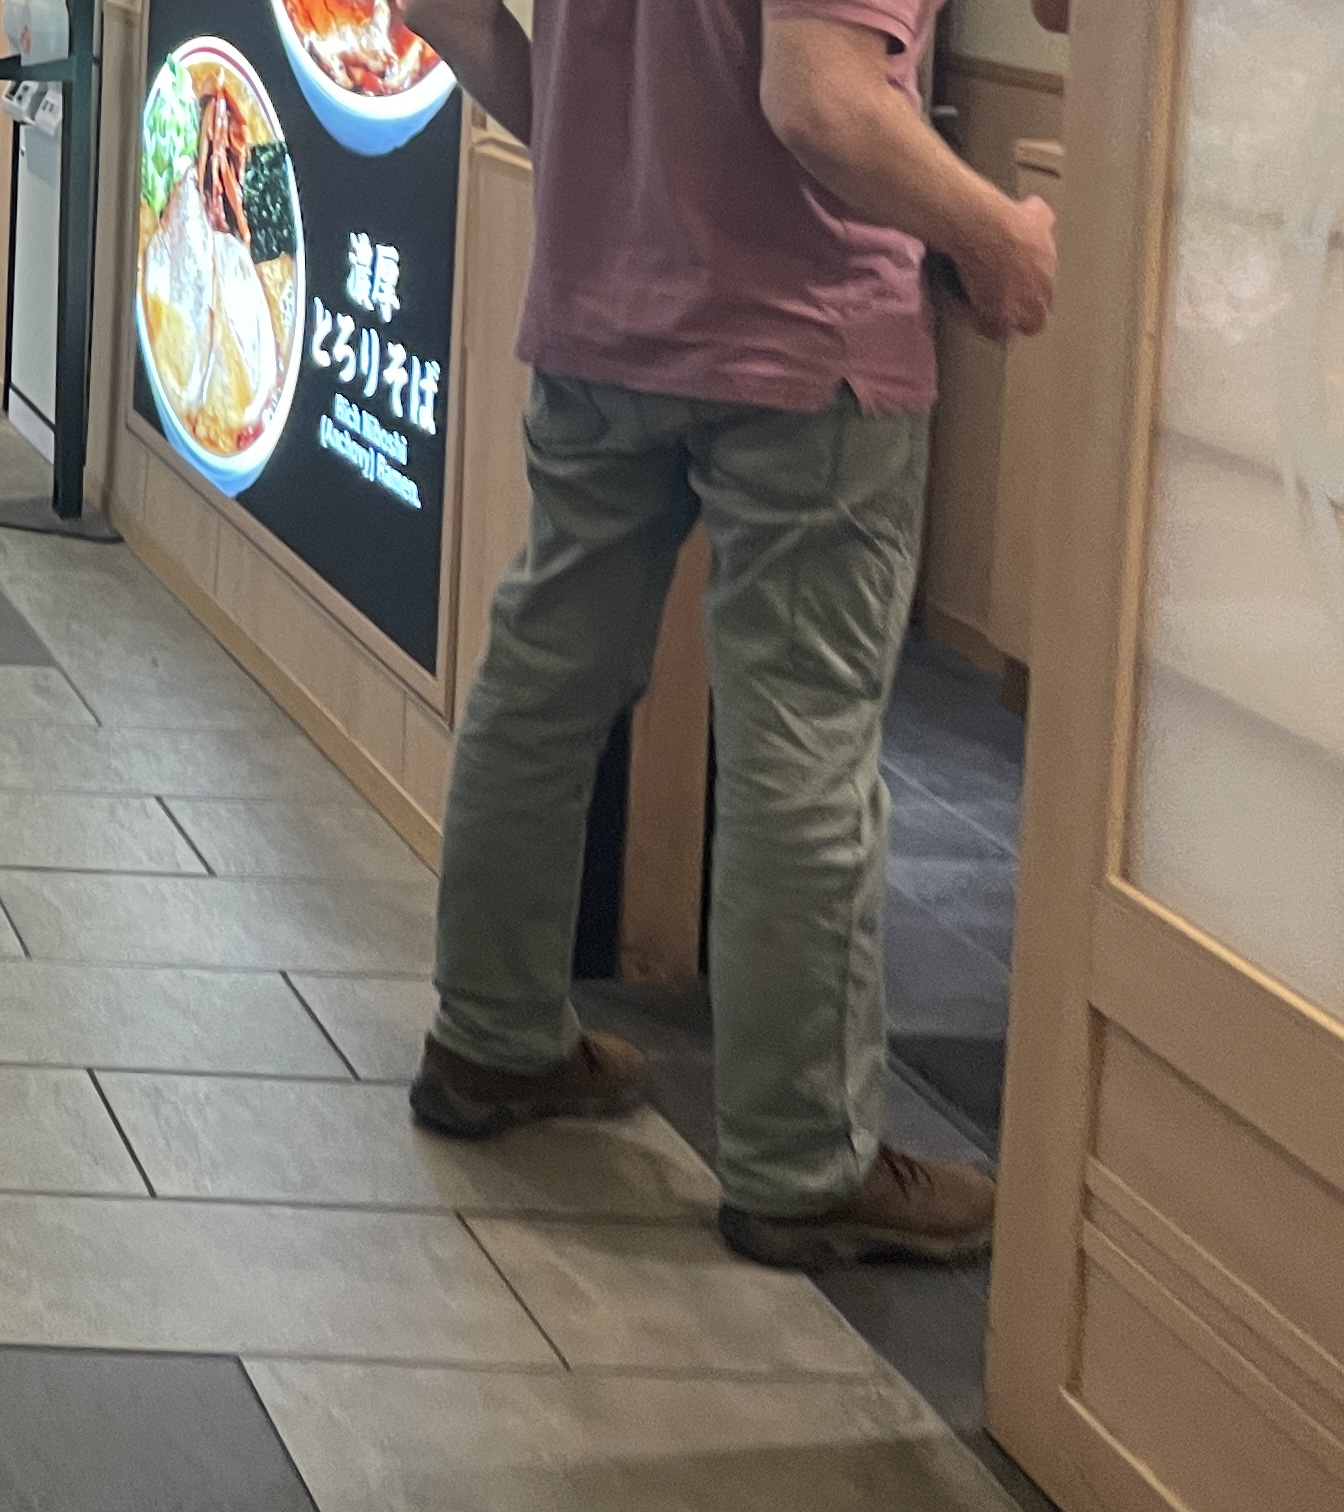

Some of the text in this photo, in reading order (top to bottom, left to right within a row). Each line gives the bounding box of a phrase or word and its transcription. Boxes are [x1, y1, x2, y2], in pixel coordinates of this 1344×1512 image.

[348, 232, 400, 323] 濃厚
[313, 296, 440, 435] とろりそば
